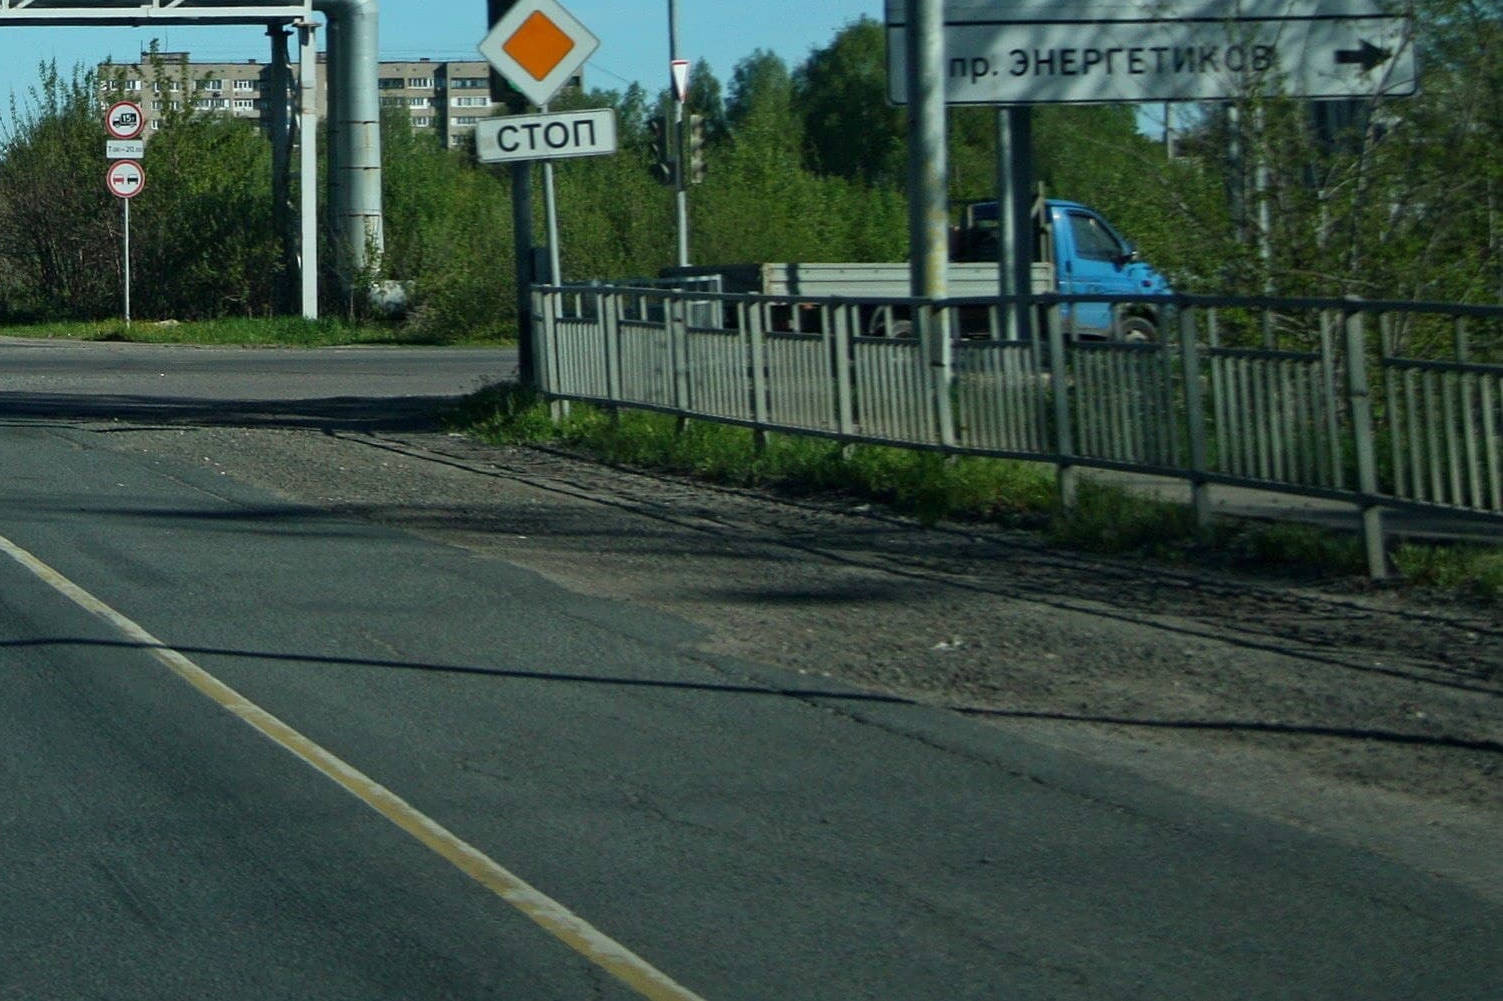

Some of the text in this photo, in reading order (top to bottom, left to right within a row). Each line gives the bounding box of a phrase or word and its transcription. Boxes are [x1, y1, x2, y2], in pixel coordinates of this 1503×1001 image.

[949, 45, 1275, 84] пр. ЭНЕРГЕТИКОВ
[497, 119, 597, 152] СТОП
